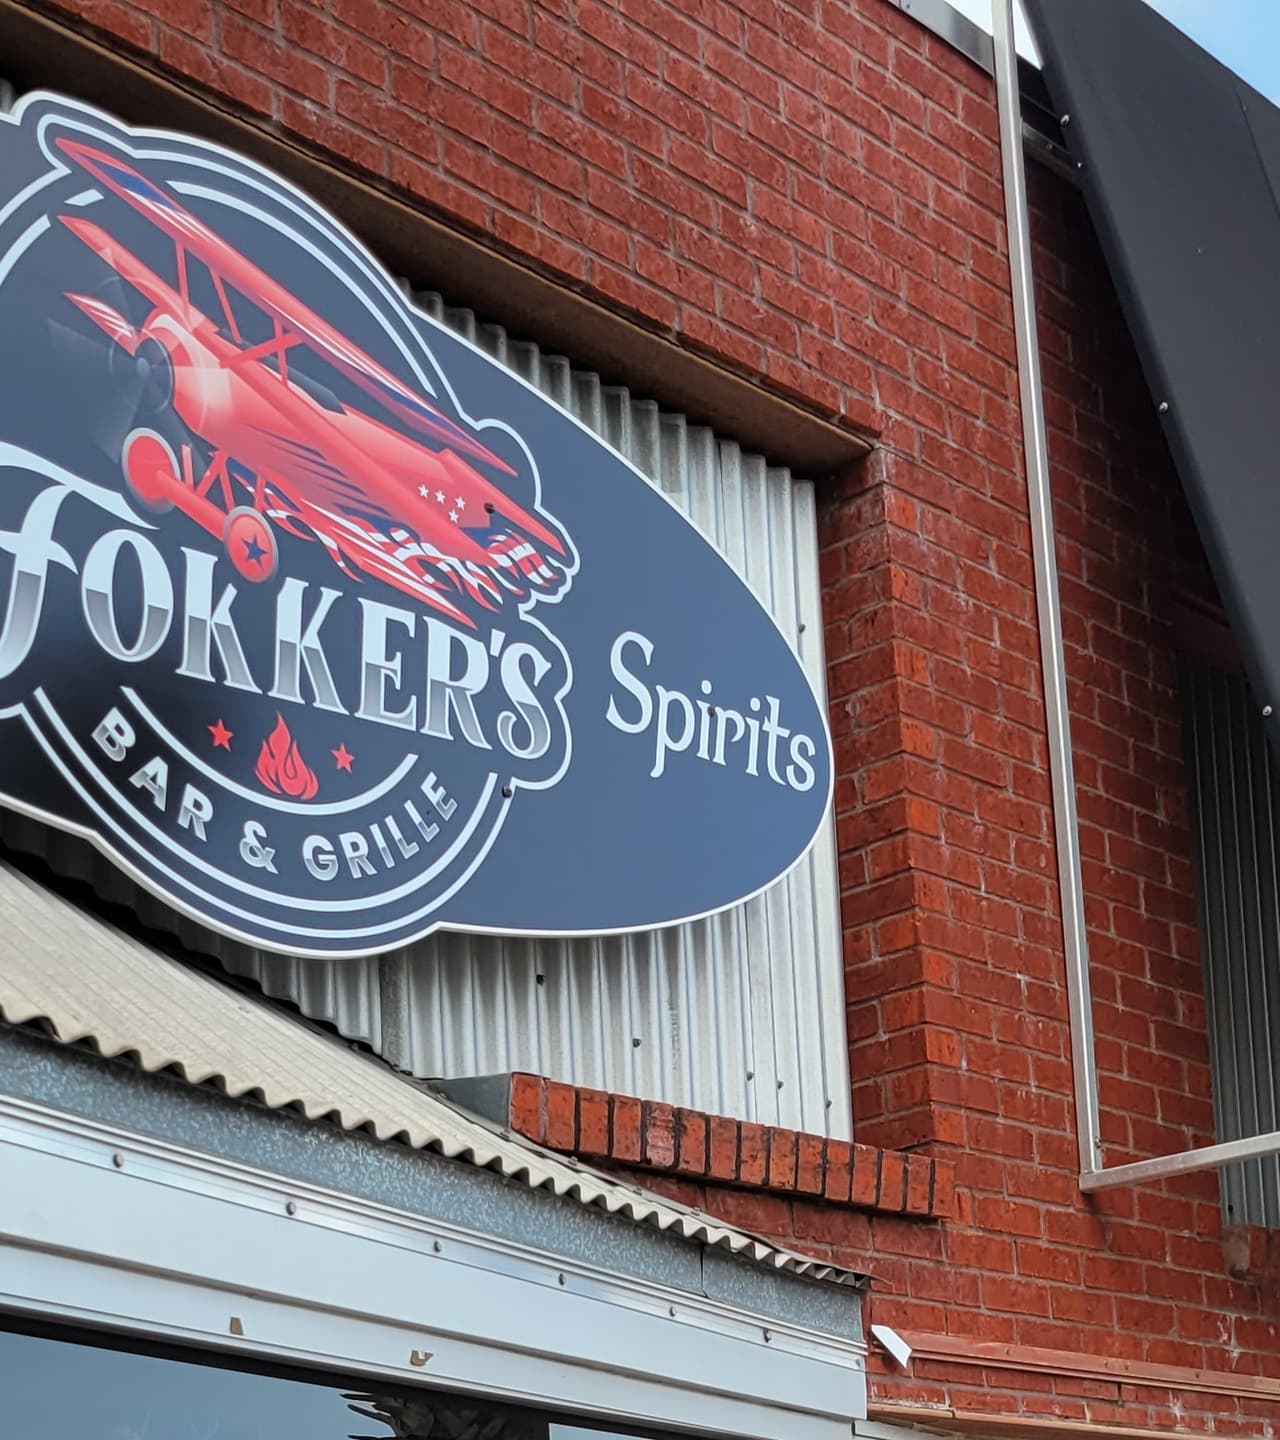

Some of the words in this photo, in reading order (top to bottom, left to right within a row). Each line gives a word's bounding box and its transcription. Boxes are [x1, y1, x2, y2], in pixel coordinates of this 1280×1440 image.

[91, 707, 214, 842] BAR
[239, 820, 280, 874] &
[303, 772, 458, 881] GRILLE
[606, 631, 816, 792] Spirits
